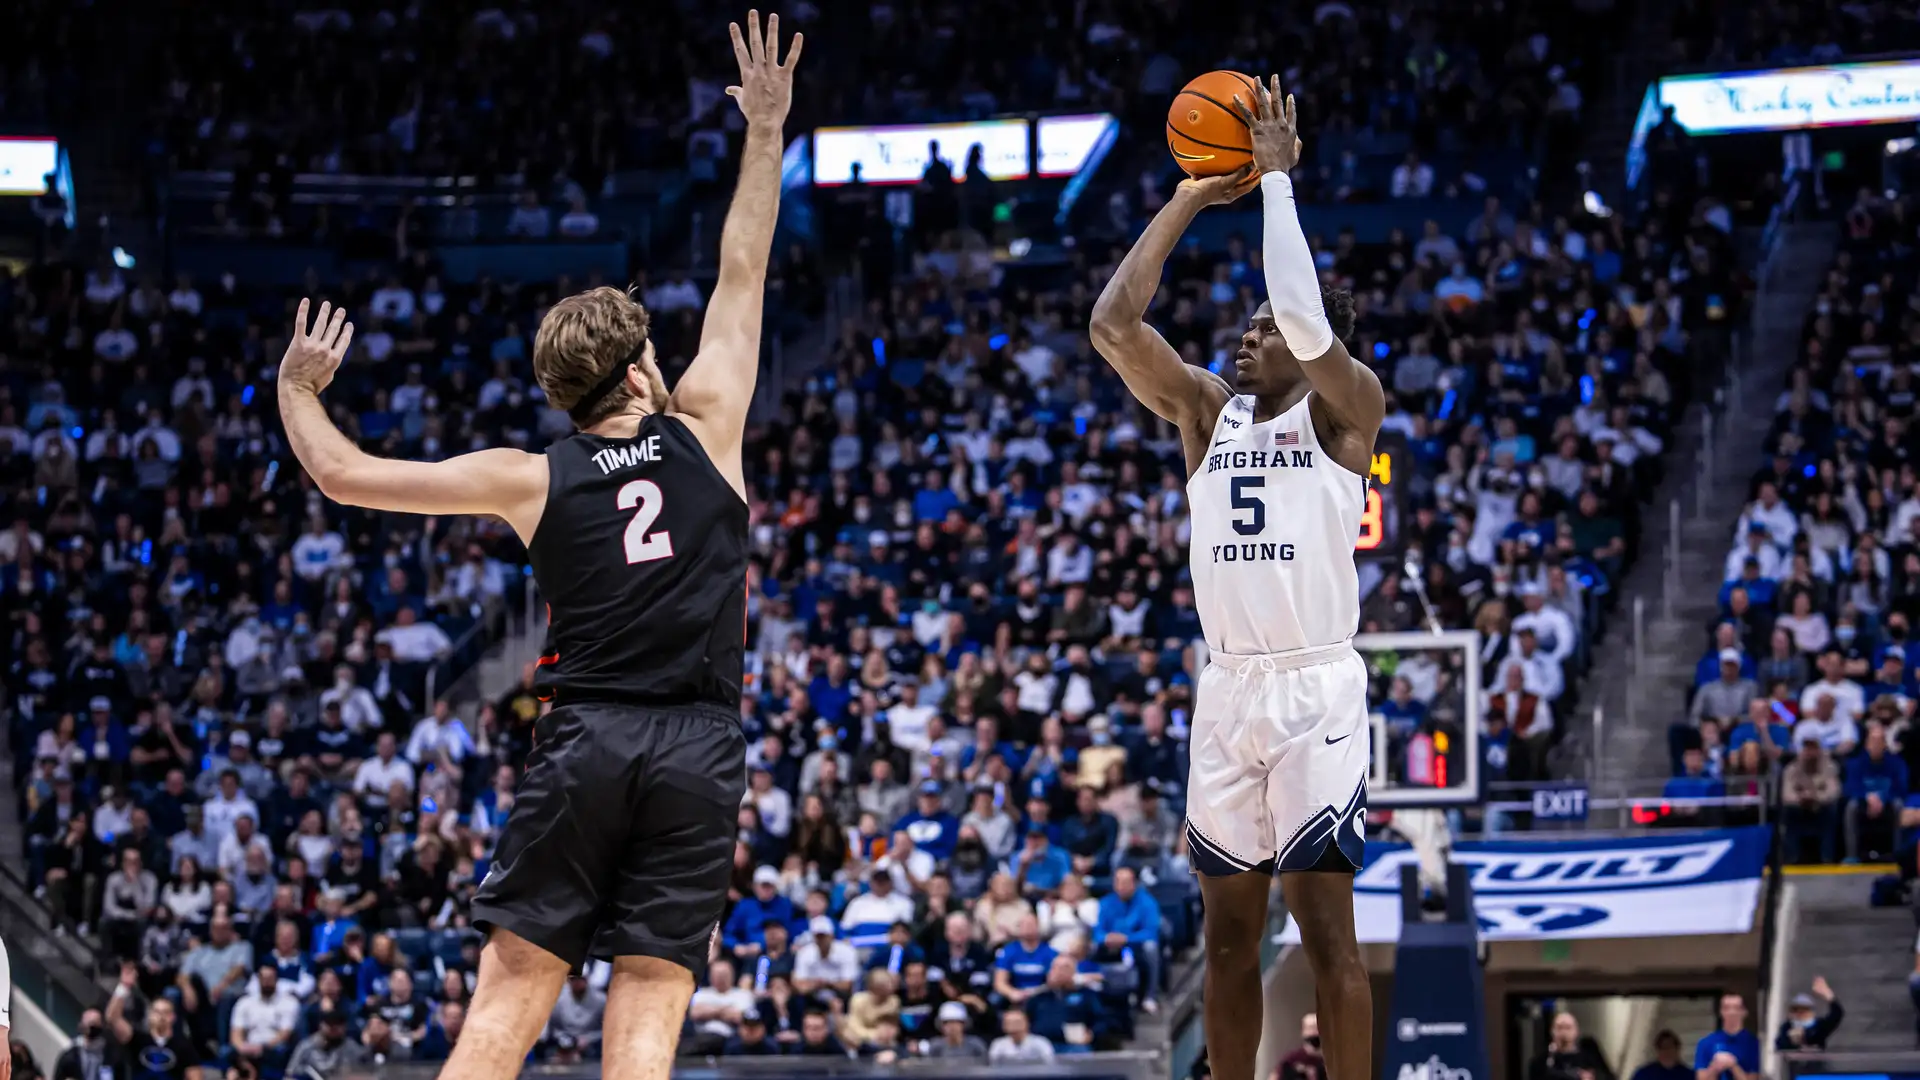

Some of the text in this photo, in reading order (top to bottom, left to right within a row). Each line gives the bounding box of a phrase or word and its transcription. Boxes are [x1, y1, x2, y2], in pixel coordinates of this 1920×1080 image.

[591, 434, 662, 475] TIMME
[1208, 450, 1314, 474] BRIGHAM
[616, 478, 675, 566] 2
[1230, 475, 1266, 536] 5
[1212, 543, 1295, 563] YOUNG
[1533, 789, 1588, 818] EXIT
